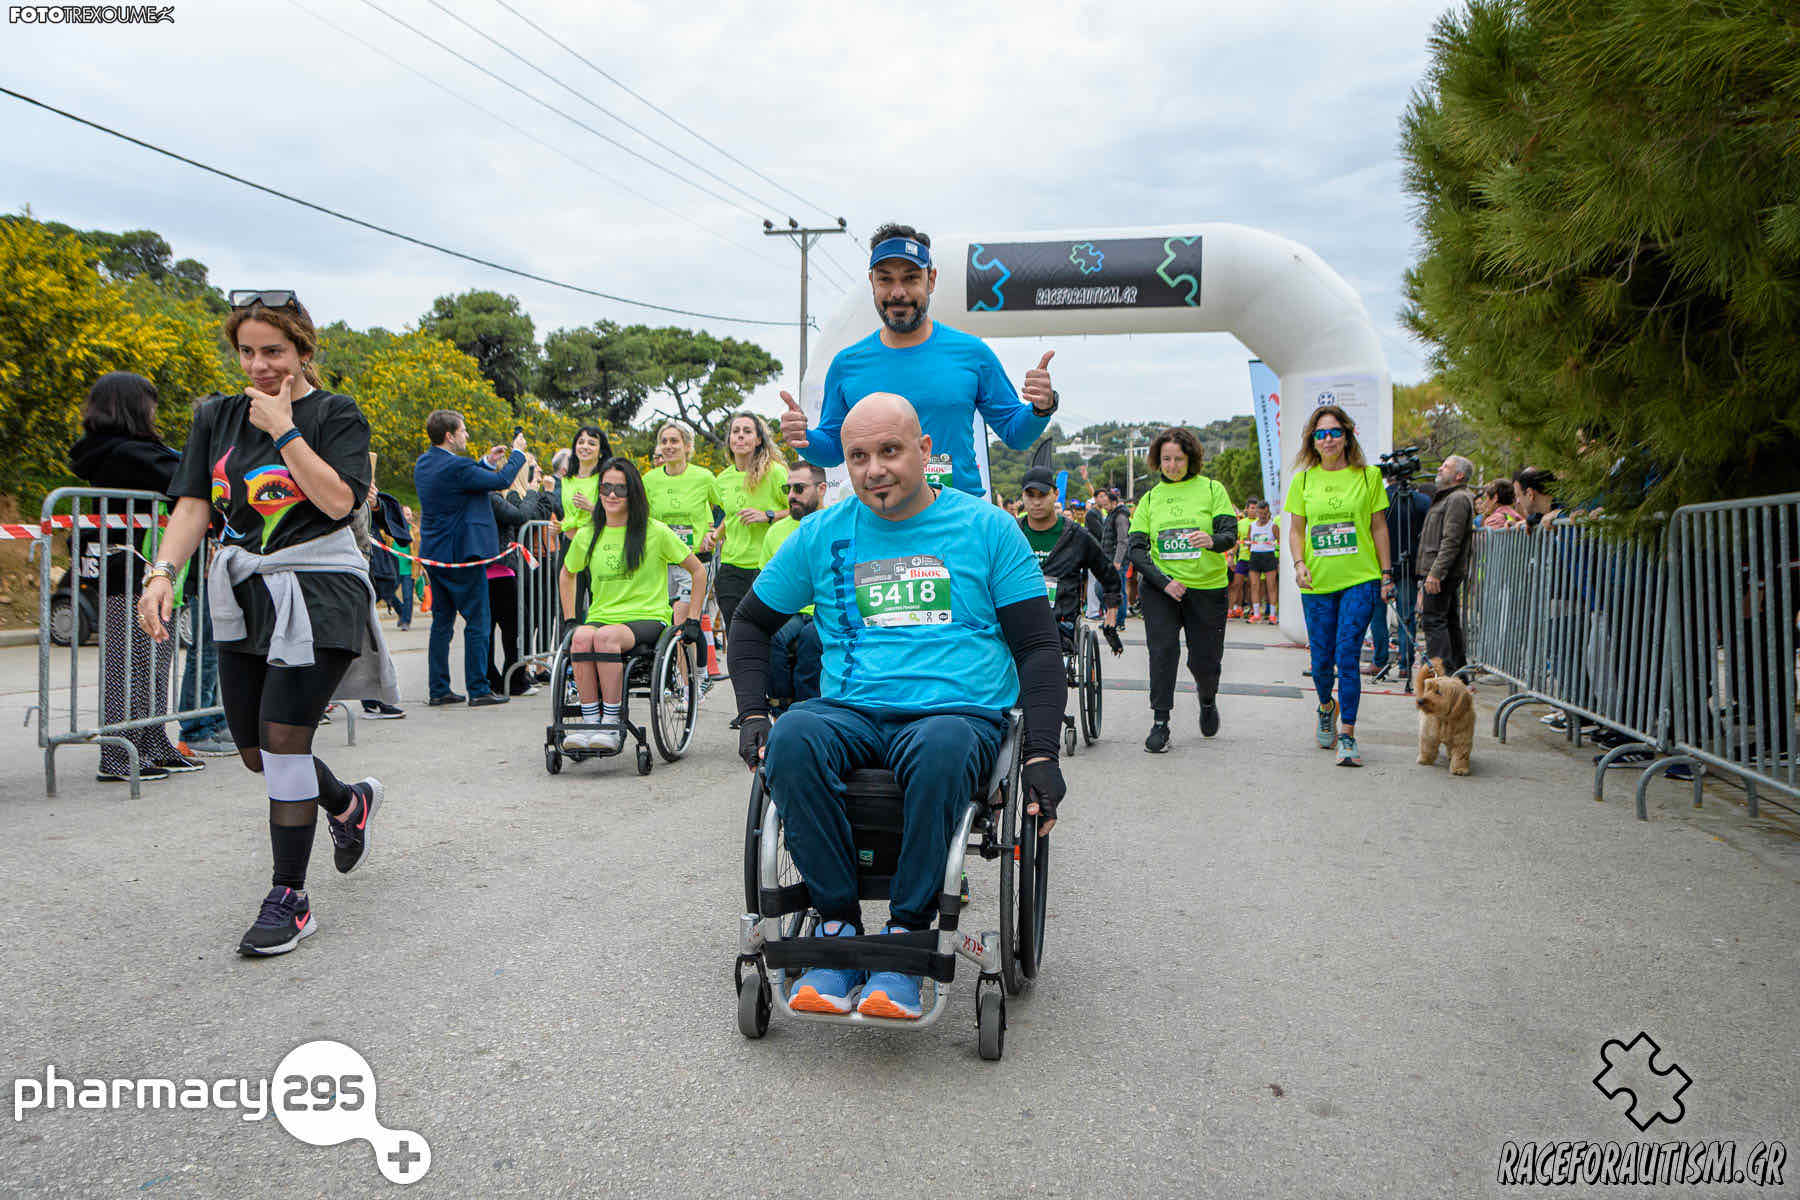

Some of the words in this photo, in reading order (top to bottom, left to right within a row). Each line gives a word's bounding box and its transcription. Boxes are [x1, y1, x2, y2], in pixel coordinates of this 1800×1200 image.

[1035, 286, 1138, 305] RACEFORAUTISM.GR
[1317, 534, 1349, 548] 5151
[868, 580, 937, 608] 5418
